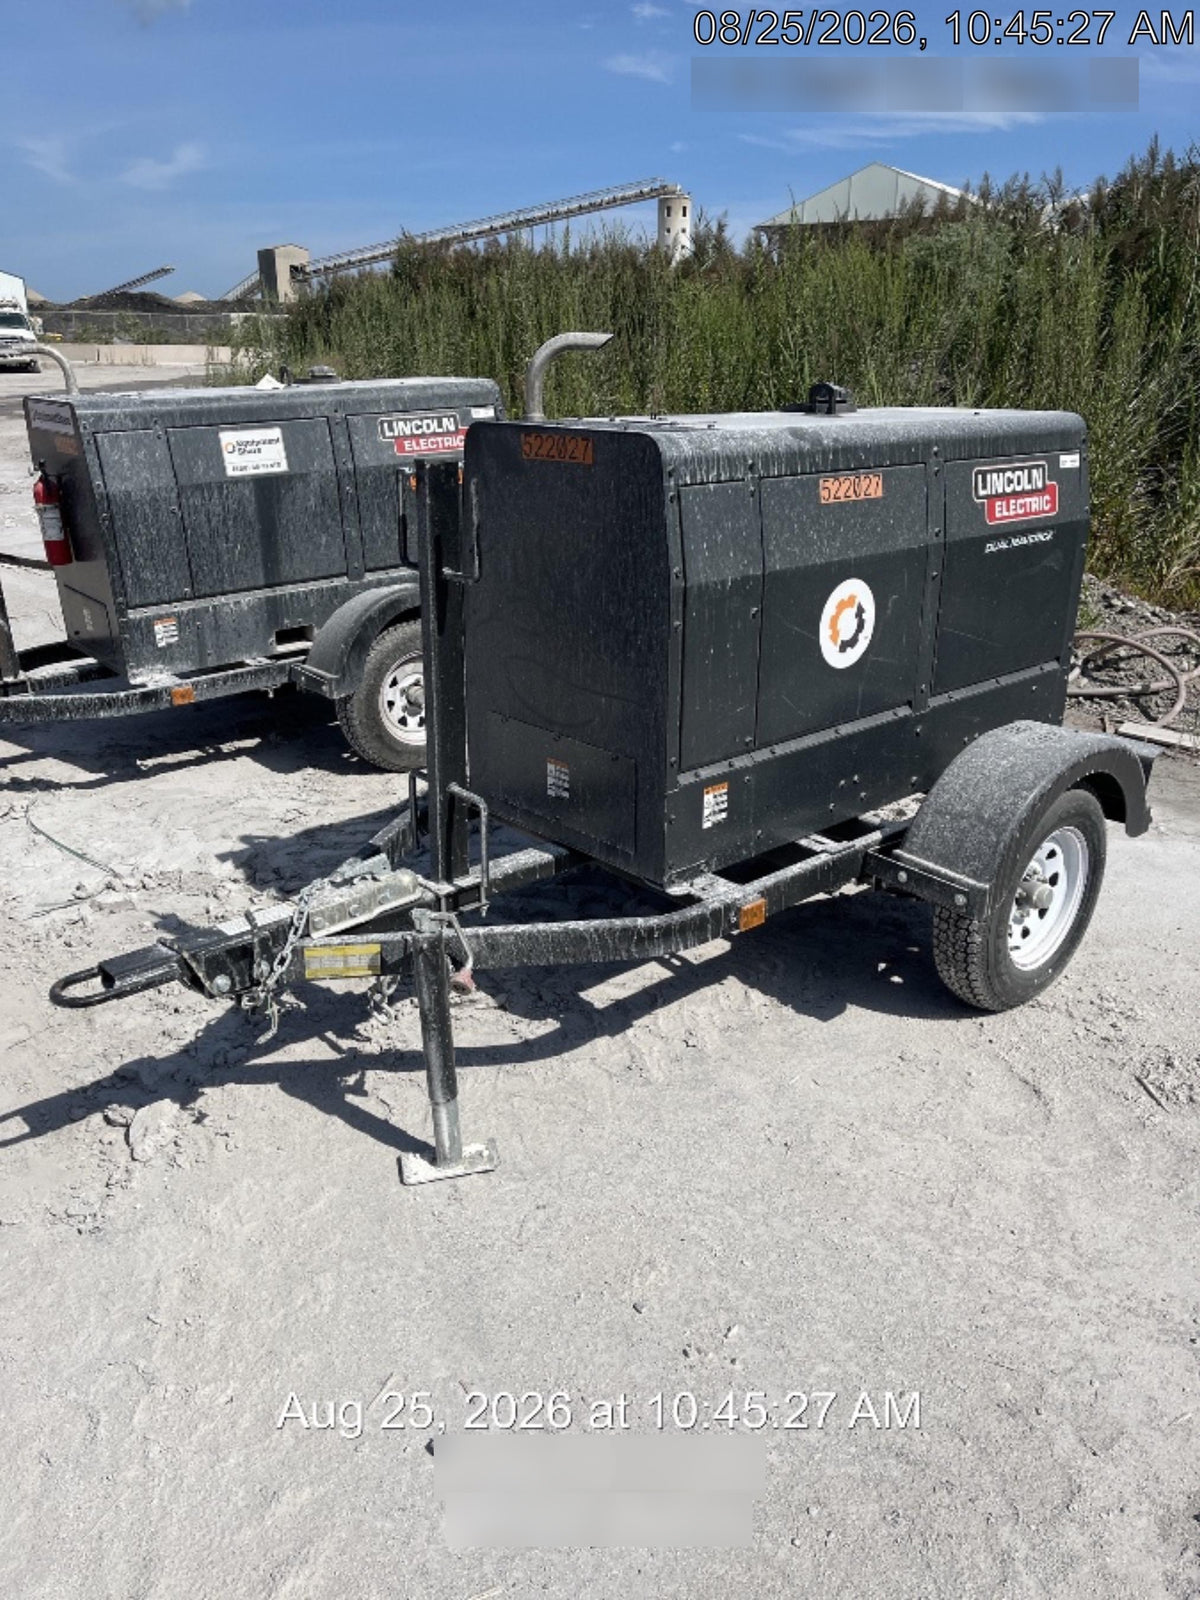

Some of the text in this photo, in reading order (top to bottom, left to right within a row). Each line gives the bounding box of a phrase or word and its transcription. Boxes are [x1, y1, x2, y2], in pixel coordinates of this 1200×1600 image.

[383, 417, 456, 437] LINCOLN
[402, 435, 465, 451] ELECTRIC
[523, 433, 591, 461] 522027
[821, 473, 881, 502] 522027
[977, 467, 1043, 496] LINCOLN
[994, 494, 1052, 518] ELECTRIC
